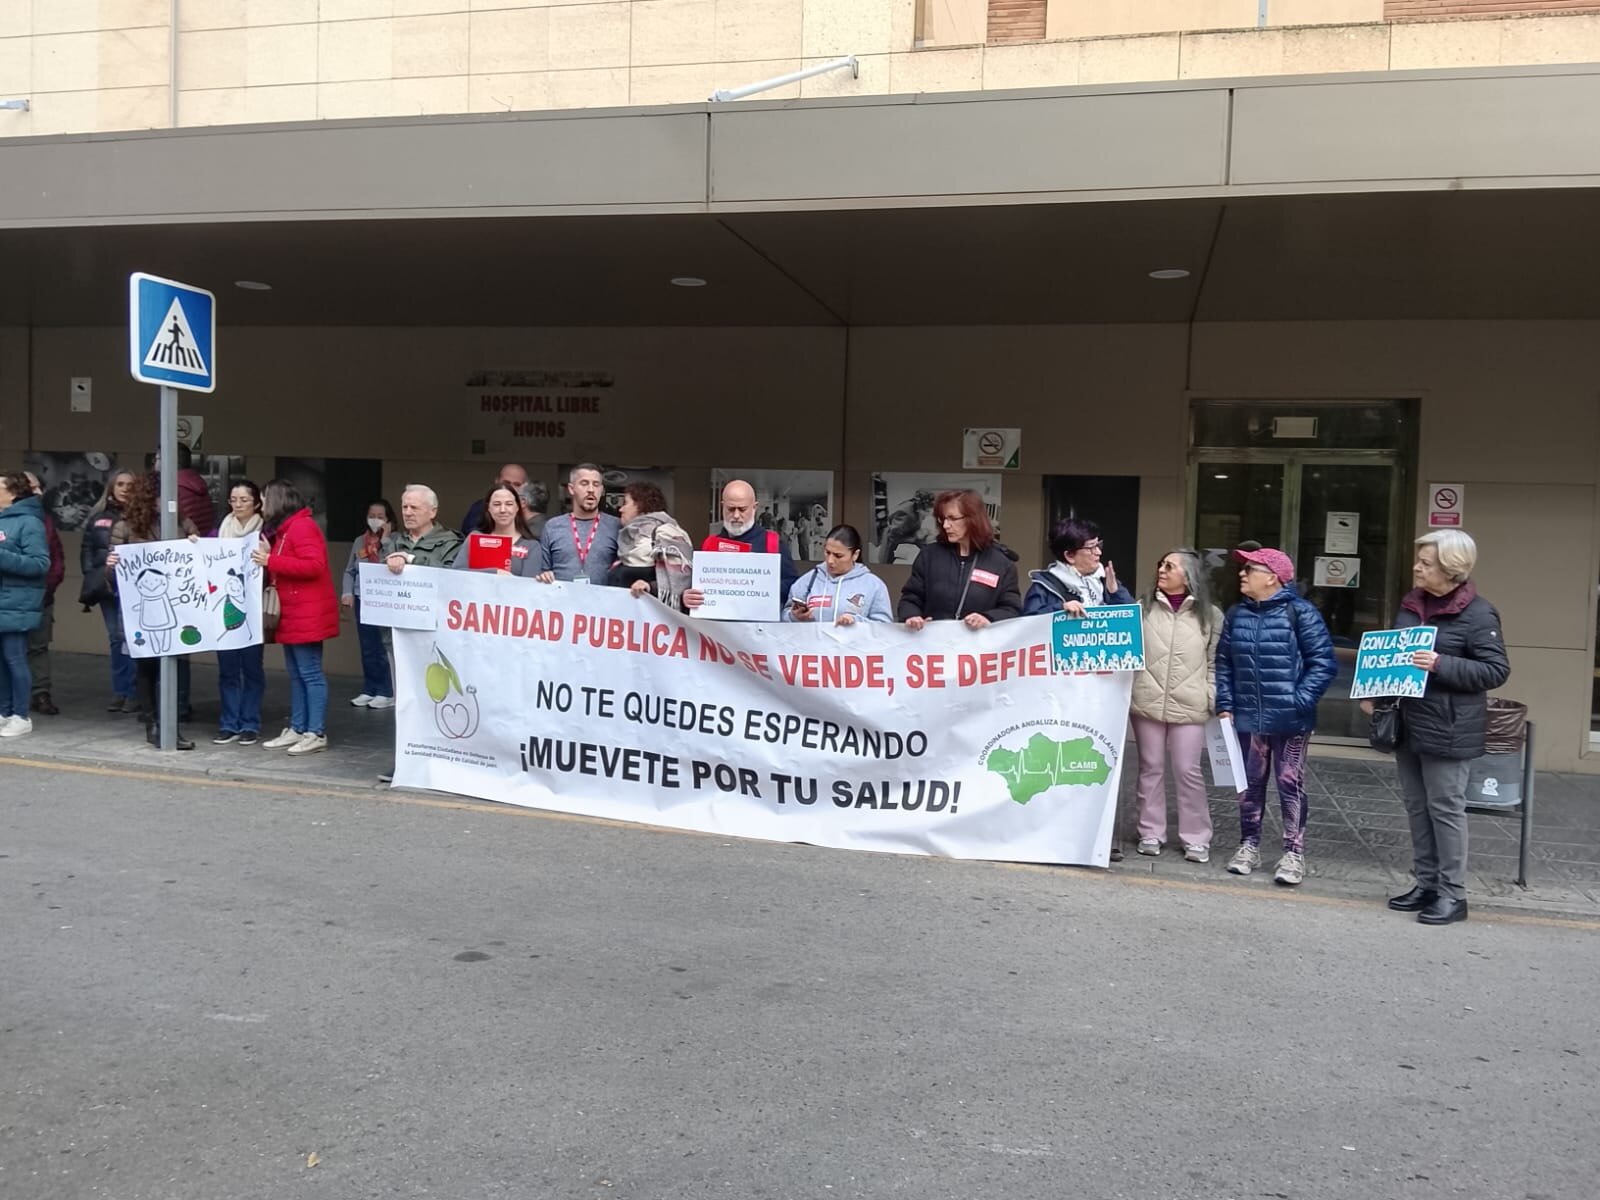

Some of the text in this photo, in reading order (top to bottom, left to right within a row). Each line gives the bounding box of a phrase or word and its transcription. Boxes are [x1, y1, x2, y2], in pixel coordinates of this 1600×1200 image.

[480, 395, 600, 413] HOSPITAL LIBRE
[513, 420, 566, 438] HUMOS
[174, 566, 194, 578] EN
[702, 566, 728, 574] QUIEREN
[728, 567, 762, 575] DEGRADAR
[402, 580, 434, 588] PRIMARIA
[394, 602, 406, 610] QUE
[1054, 614, 1067, 623] NO
[1086, 610, 1134, 619] RECORTES
[1081, 620, 1108, 629] EN LA
[1062, 629, 1132, 648] SANIDAD PÚBLICA
[1362, 636, 1385, 650] CON
[1385, 635, 1398, 650] LA
[448, 600, 564, 642] SANIDAD
[572, 614, 689, 658] PUBLICA
[698, 632, 736, 666] NO
[736, 650, 774, 681] SE
[778, 654, 894, 696] VENDE,
[906, 654, 946, 689] SE
[1362, 654, 1376, 669] NO
[536, 680, 928, 760] NO TE QUEDES ESPERANDO
[408, 742, 436, 751] Plataforma
[978, 724, 1020, 766] COORDINADORA
[1021, 718, 1058, 728] ANDALUZA
[1072, 722, 1098, 737] MAREAS
[1070, 762, 1098, 770] CAMB
[520, 736, 962, 814] ¡MUEVETE POR TU SALUD!
